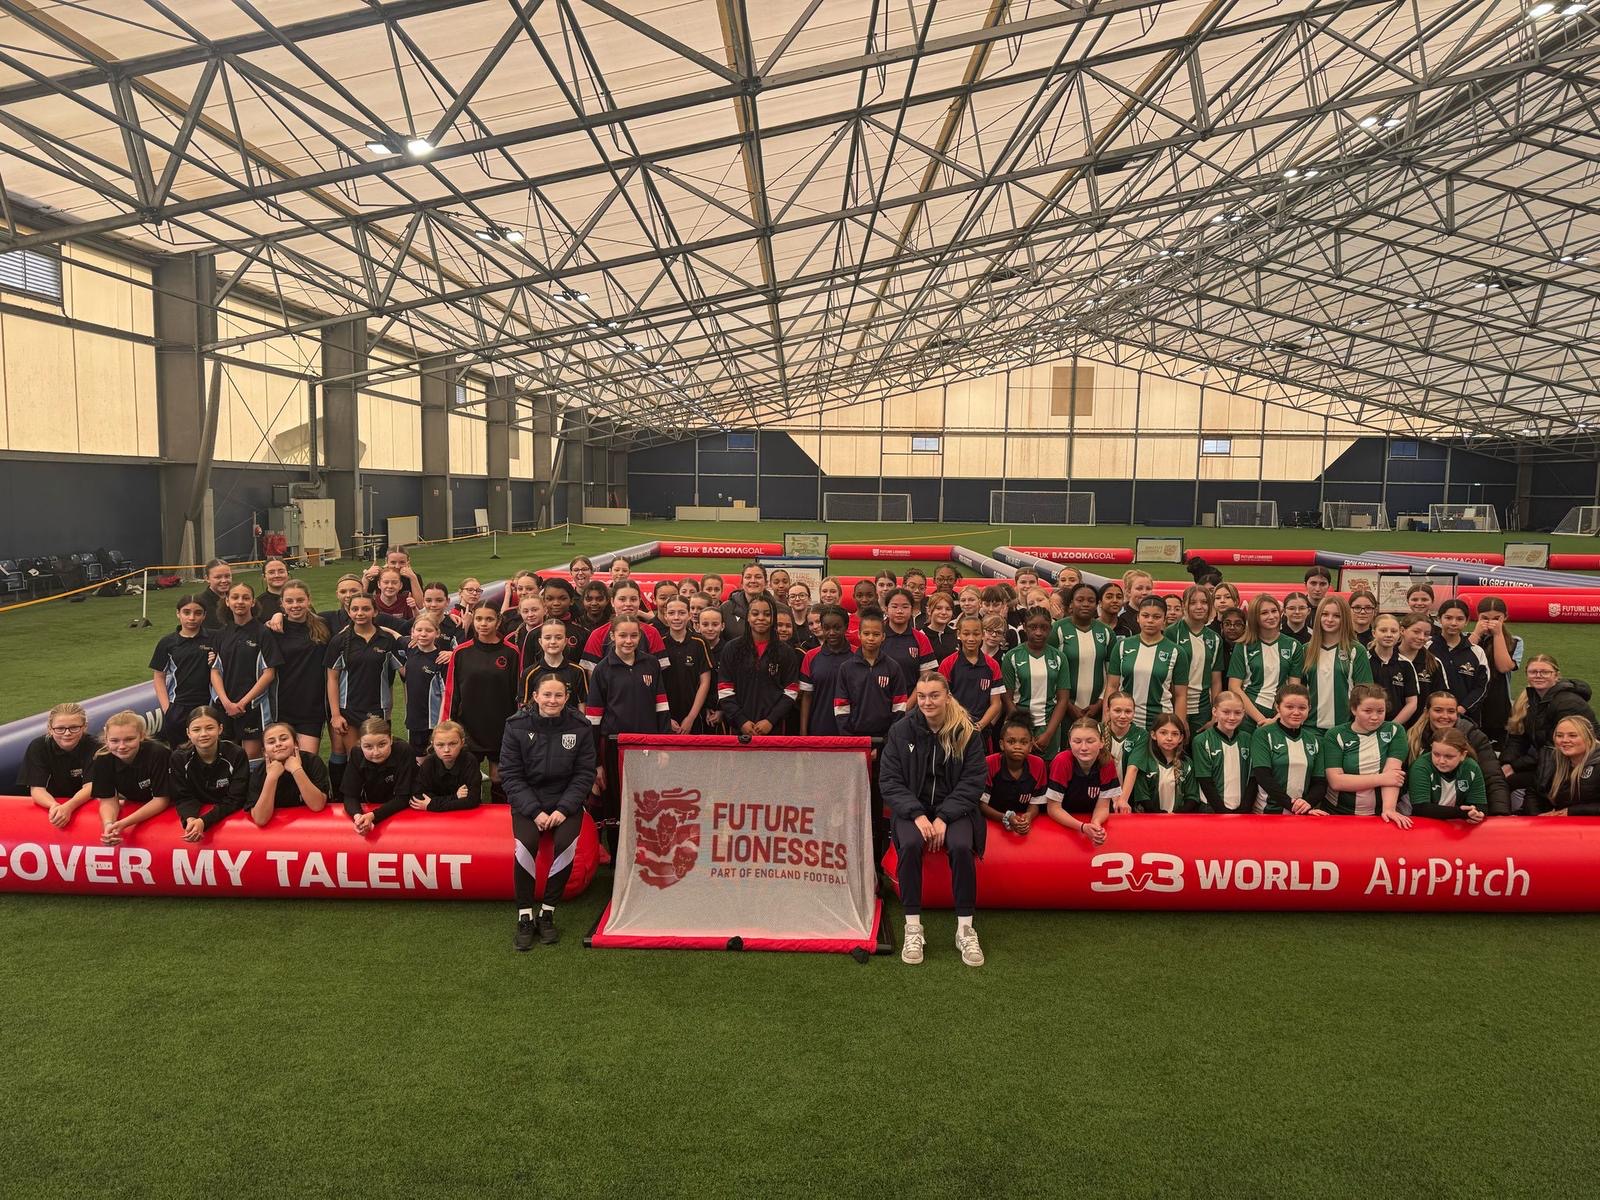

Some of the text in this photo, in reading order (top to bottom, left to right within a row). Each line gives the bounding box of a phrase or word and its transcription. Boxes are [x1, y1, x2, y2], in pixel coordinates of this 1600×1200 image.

[702, 546, 764, 554] BAZOOKAGOAL
[1052, 551, 1115, 560] BAZOOKAGOAL
[1479, 577, 1488, 586] TO
[712, 802, 815, 835] FUTURE
[711, 835, 848, 870] LIONESSES
[0, 842, 473, 890] OVER MY TALENT
[710, 867, 849, 885] PART OF ENGLAND FOOTBAL
[1194, 858, 1340, 891] WORLD
[1363, 856, 1531, 897] AirPitch
